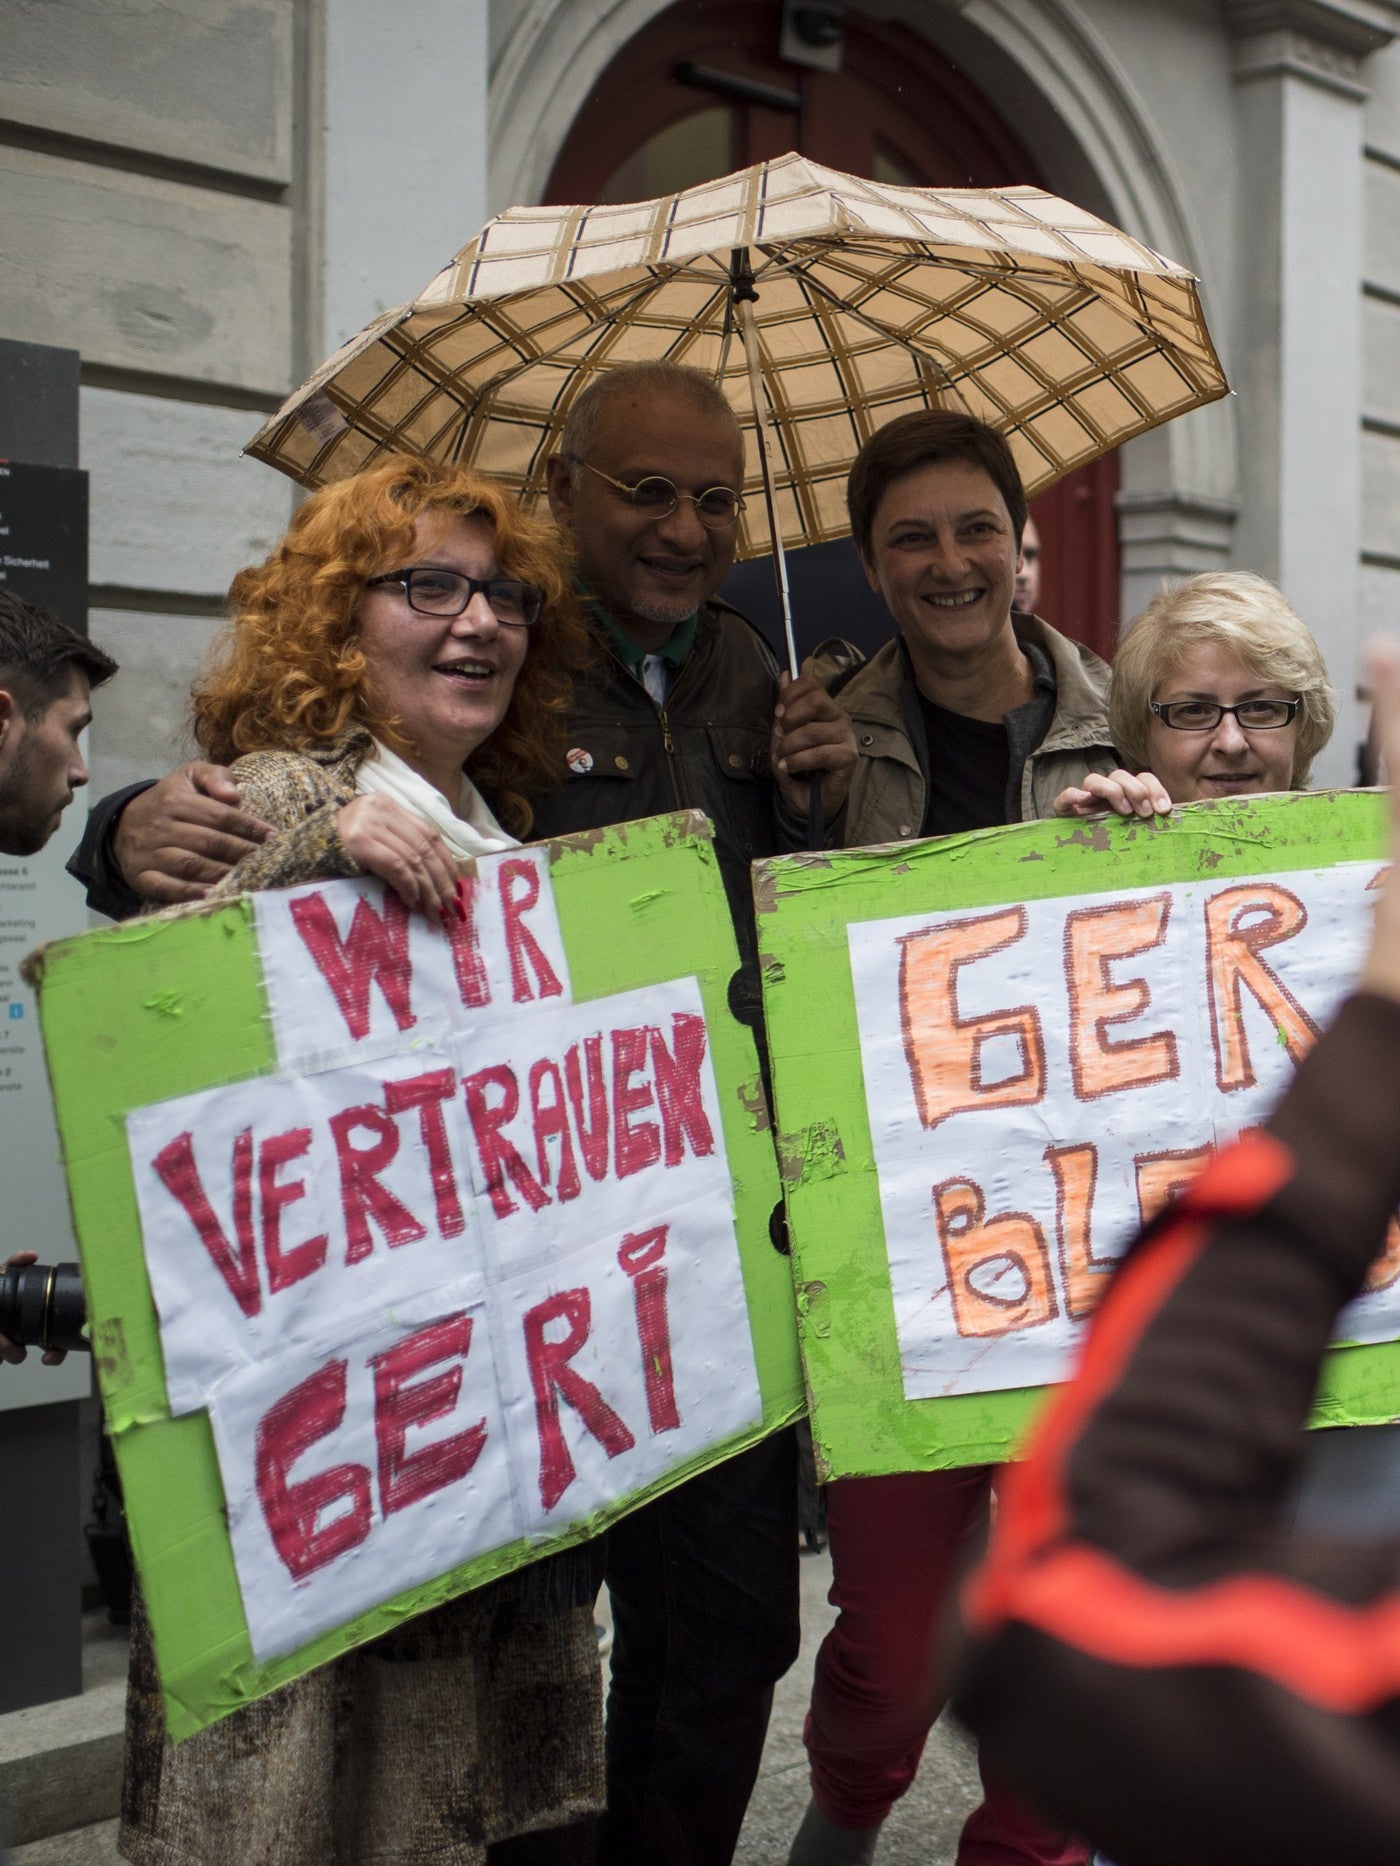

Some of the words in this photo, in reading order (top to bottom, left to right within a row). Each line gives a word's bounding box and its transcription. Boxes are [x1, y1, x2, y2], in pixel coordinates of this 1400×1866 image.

[289, 859, 564, 1041] WIR
[895, 866, 1394, 1131] GER
[151, 1012, 715, 1318] VERTRAUEN
